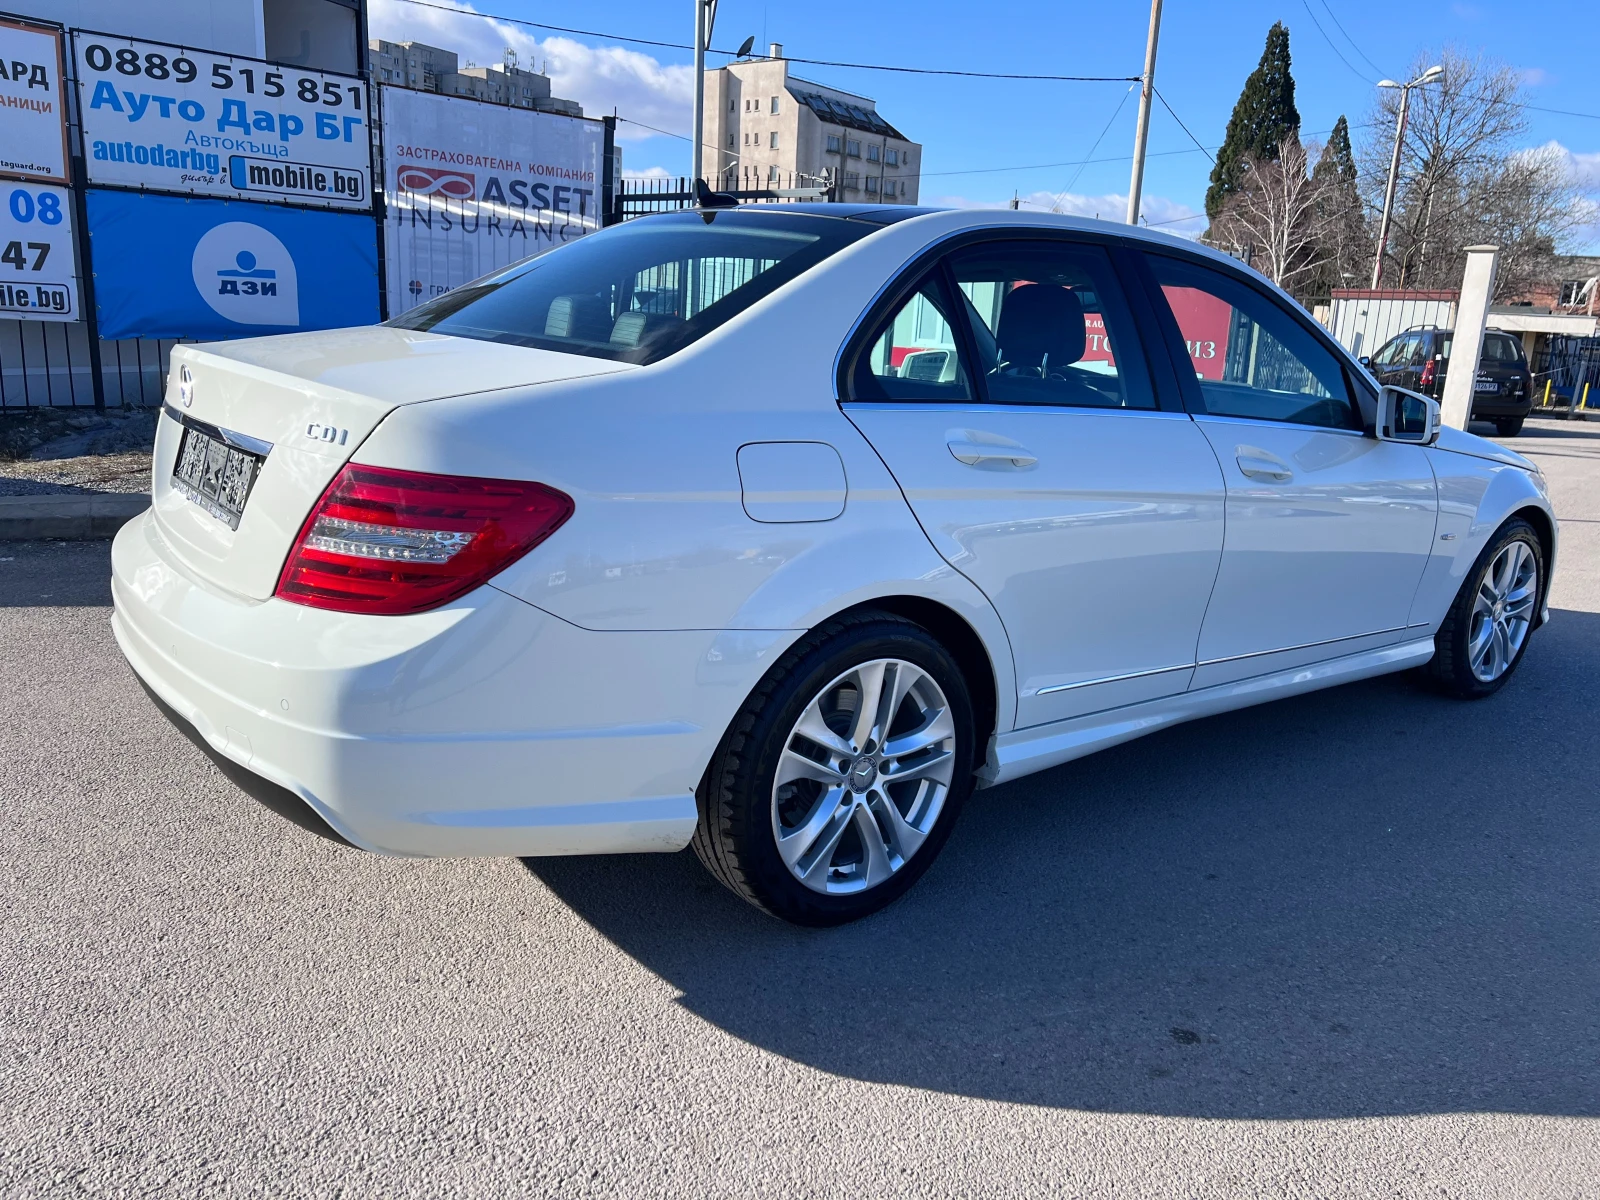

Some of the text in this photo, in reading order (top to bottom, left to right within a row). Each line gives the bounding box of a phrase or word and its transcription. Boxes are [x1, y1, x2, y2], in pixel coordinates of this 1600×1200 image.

[85, 44, 361, 110] 0889 515 851
[90, 80, 362, 143] Ауто Дар БГ
[185, 130, 289, 158] Автокъща
[249, 165, 359, 197] mobile.bg
[397, 145, 594, 182] ЗАСТРАХОВАТЕЛНА КОМПАНИЯ
[10, 189, 62, 225] 08
[482, 176, 593, 216] ASSET
[398, 206, 587, 242] INSURANC
[1, 241, 51, 271] 47
[219, 280, 277, 296] ДЗИ
[306, 423, 348, 446] CDI
